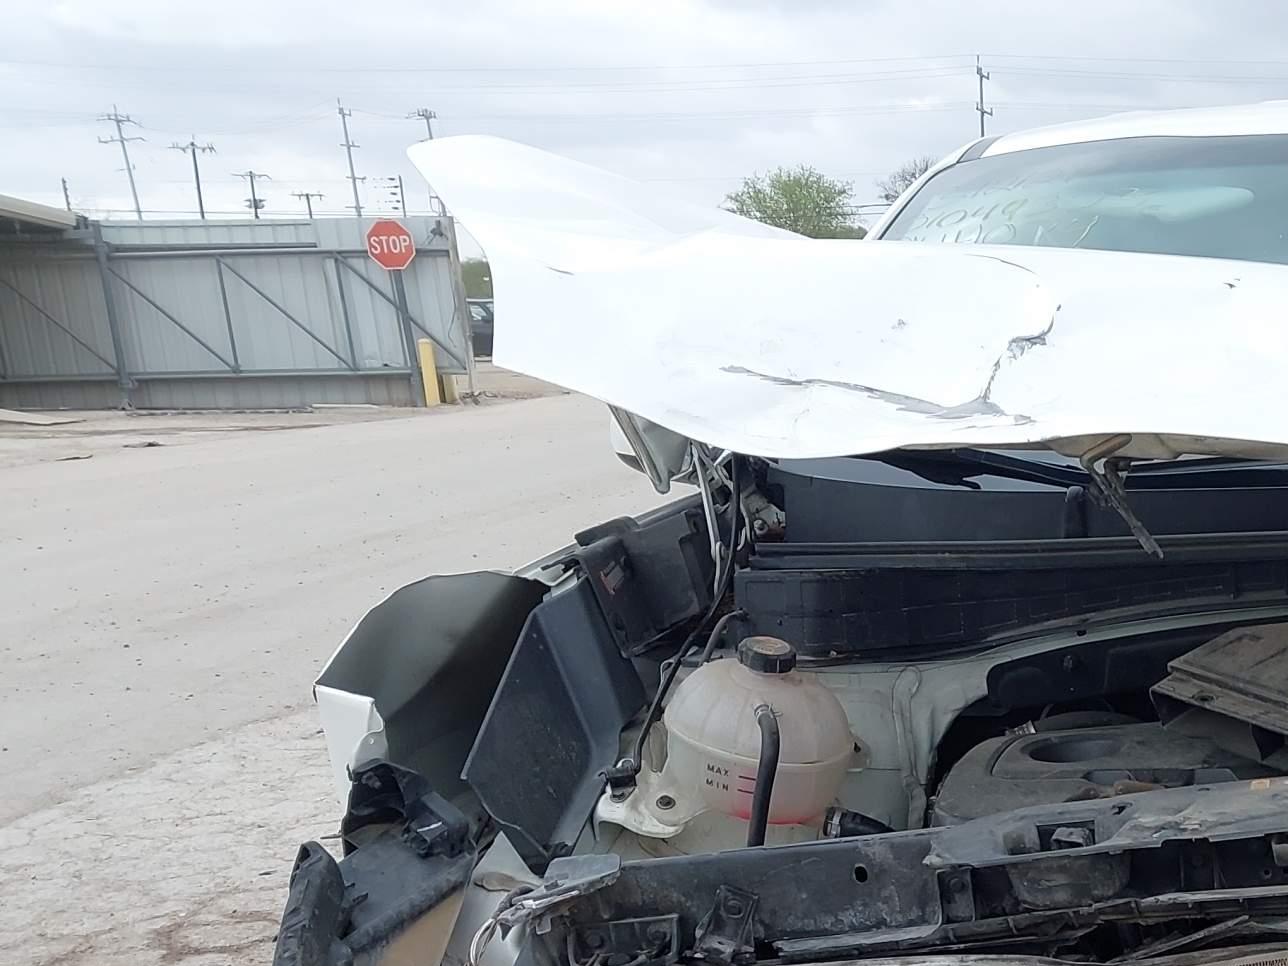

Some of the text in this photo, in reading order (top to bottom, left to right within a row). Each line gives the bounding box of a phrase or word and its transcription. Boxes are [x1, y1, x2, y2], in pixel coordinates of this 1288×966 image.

[370, 235, 410, 254] STOP
[706, 763, 729, 776] MAX
[705, 778, 729, 791] MIN
